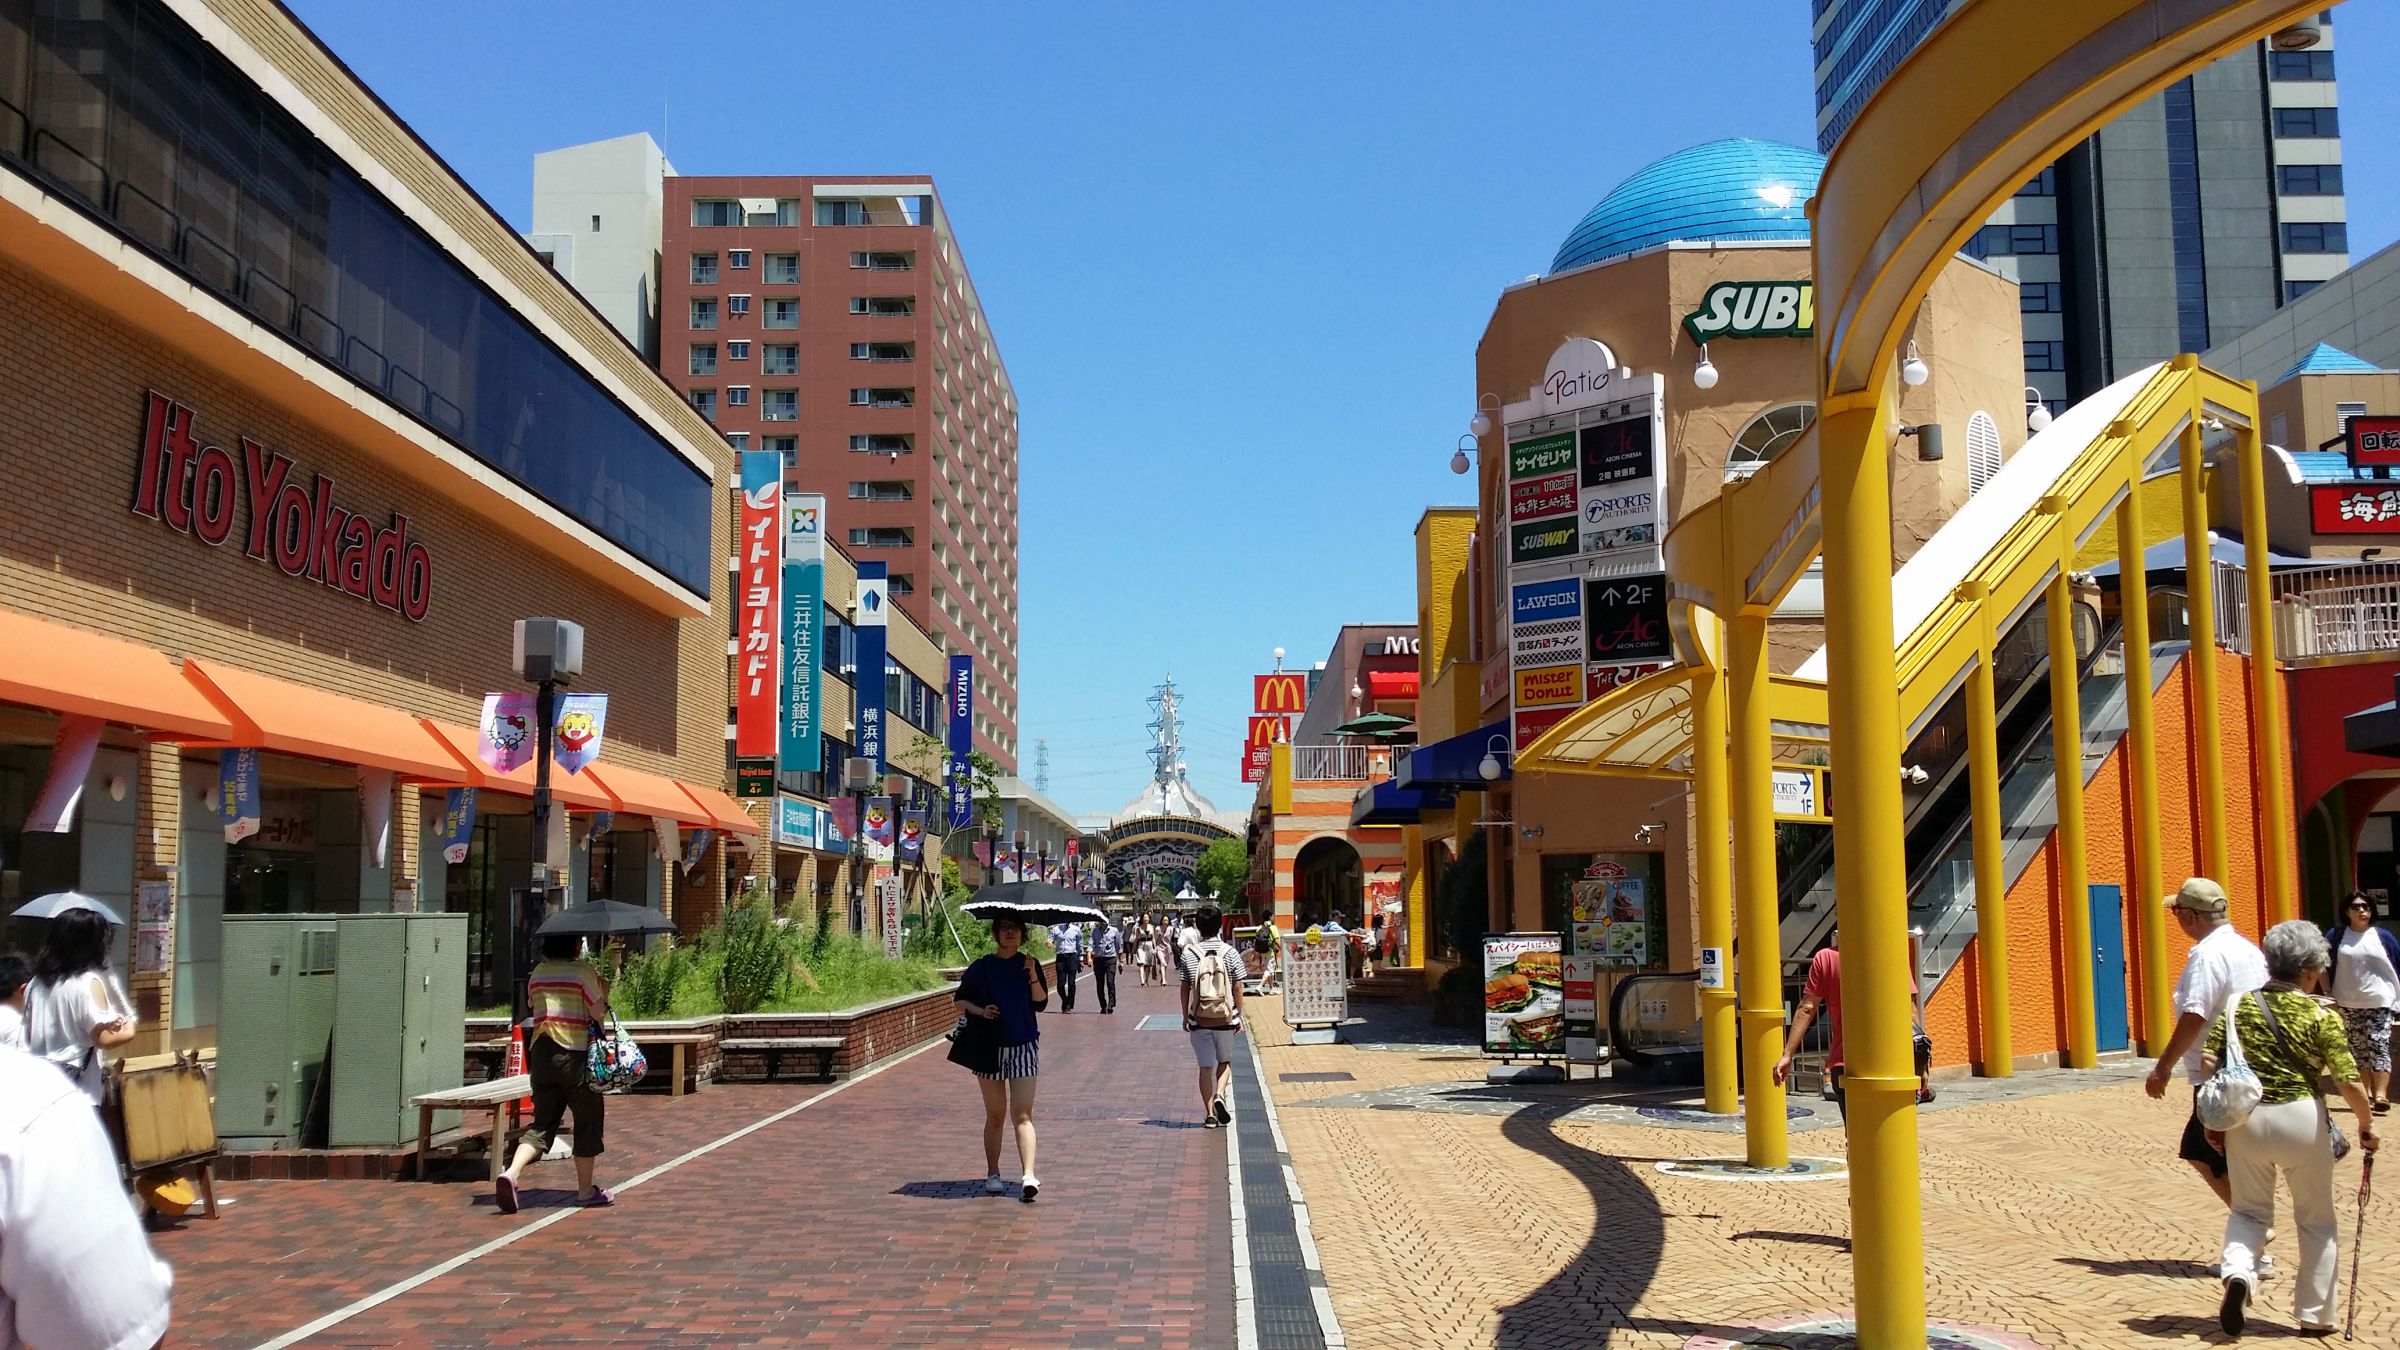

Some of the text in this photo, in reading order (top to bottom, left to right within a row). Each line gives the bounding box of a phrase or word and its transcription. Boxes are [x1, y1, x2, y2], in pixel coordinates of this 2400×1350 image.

[1693, 285, 1814, 334] SUB
[1544, 369, 1609, 405] Patio
[1515, 449, 1572, 472] サイゼリヤ
[1605, 450, 1642, 463] AEON CINEMA
[1514, 493, 1576, 515] 海鮮三崎港
[1602, 492, 1651, 512] SPORTS
[1604, 505, 1650, 520] AUTHORITY
[1519, 527, 1576, 551] SUBWAY
[1517, 591, 1577, 611] LAWSON
[1627, 584, 1653, 605] 2F
[745, 516, 772, 697] イトーヨーカドー
[1551, 635, 1578, 647] ラーメン
[1616, 640, 1660, 650] AEON CINEMA
[790, 594, 812, 739] 三井住友信託銀行
[1593, 672, 1613, 689] THE
[957, 669, 968, 718] MIZUHO
[1524, 685, 1574, 700] Donut
[862, 708, 878, 769] 横浜銀
[740, 768, 772, 778] Royal Host
[750, 786, 761, 794] 4F
[1801, 798, 1812, 814] 1F
[1131, 856, 1159, 870] Sanrio
[1583, 962, 1592, 971] 2F
